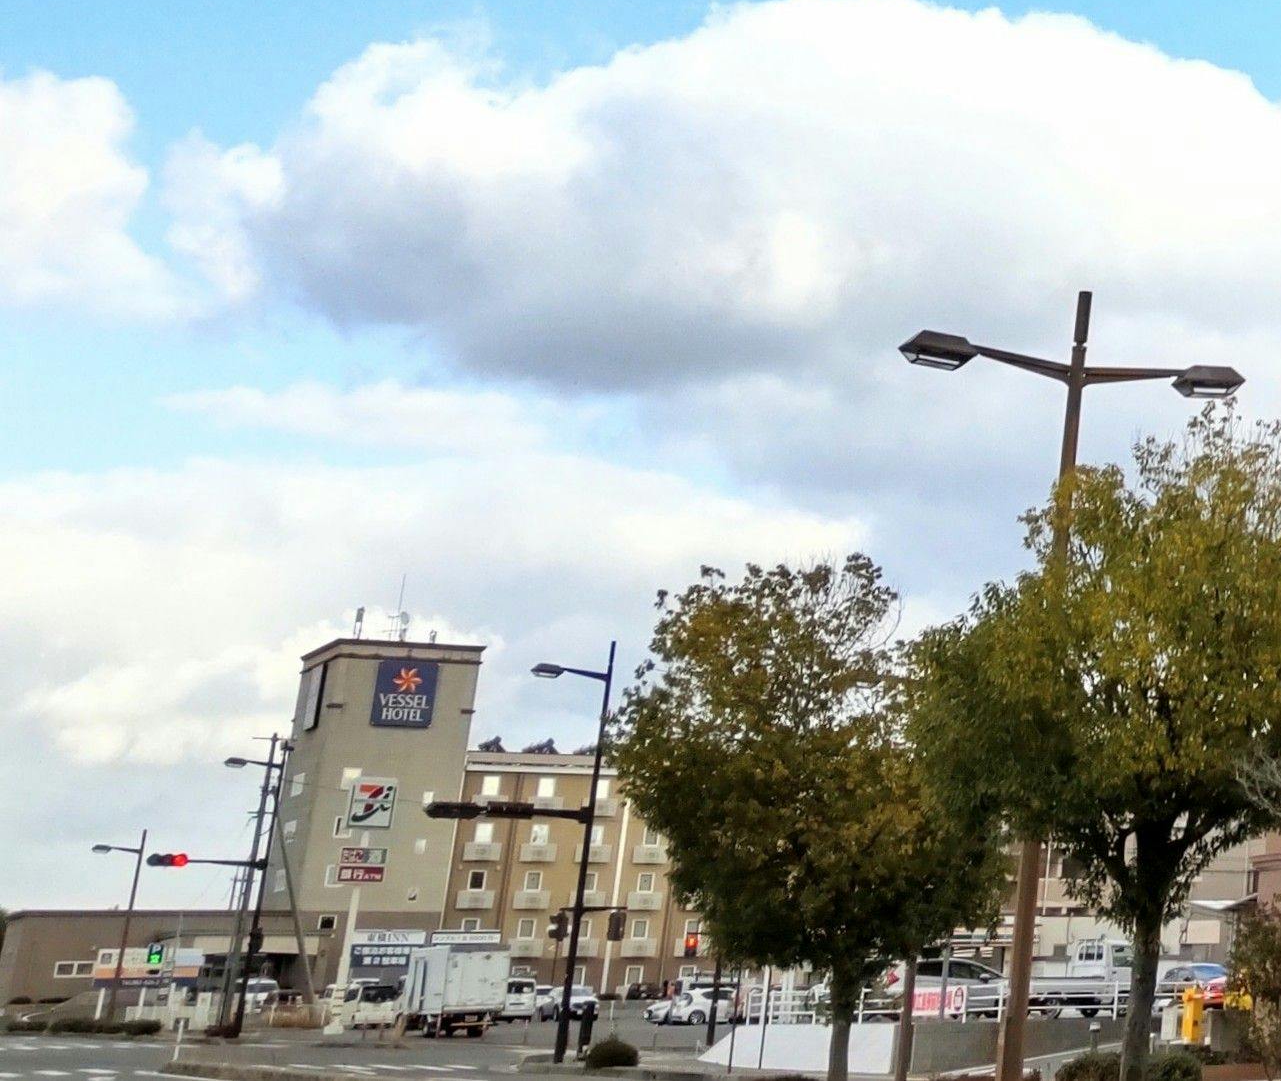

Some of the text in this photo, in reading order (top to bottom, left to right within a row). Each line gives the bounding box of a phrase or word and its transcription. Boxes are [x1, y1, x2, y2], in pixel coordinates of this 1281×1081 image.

[379, 693, 429, 709] VESSEL
[381, 707, 424, 721] HOTEL
[152, 944, 162, 952] P
